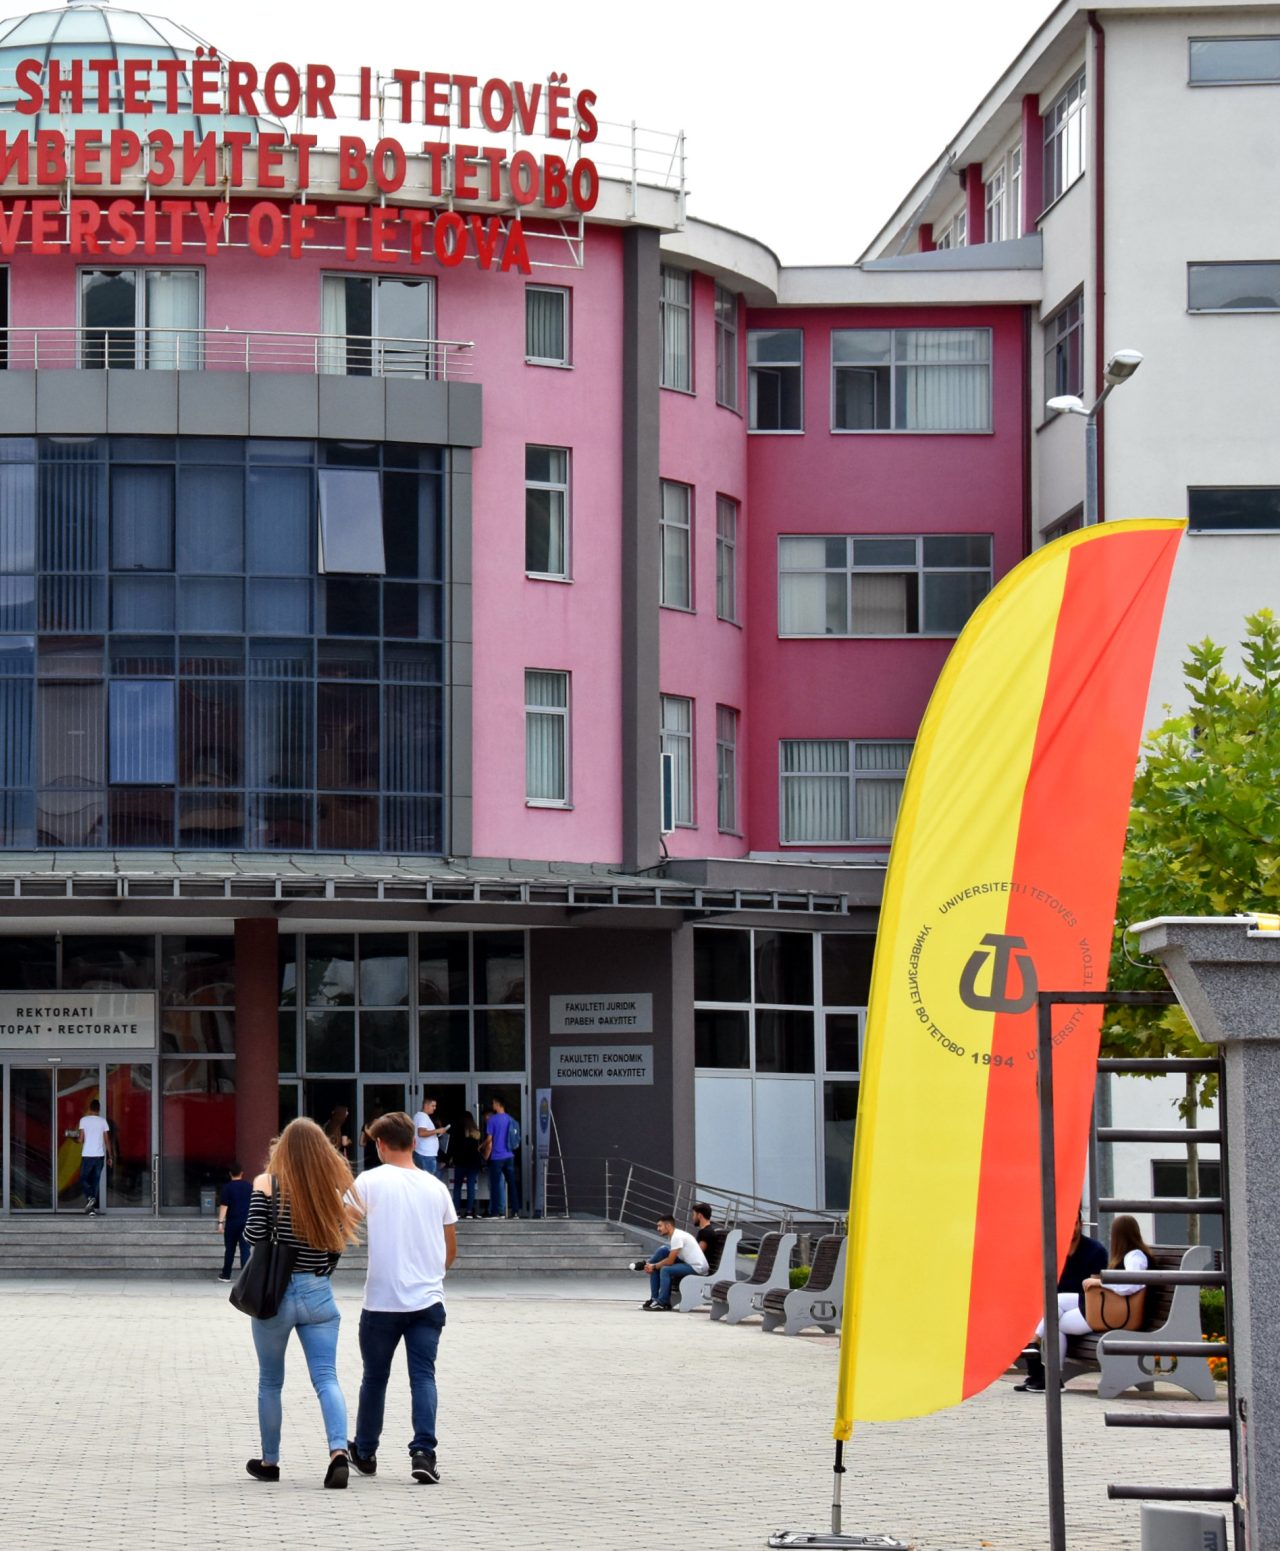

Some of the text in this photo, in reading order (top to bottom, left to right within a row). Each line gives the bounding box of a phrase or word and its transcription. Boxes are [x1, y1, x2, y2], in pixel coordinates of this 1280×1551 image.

[15, 46, 336, 119] SHTETËROR
[360, 66, 371, 121] I
[393, 71, 598, 143] TETOVËS
[339, 135, 407, 194] ВО
[424, 141, 600, 213] ТЕТОВО
[248, 201, 318, 259] OF
[335, 205, 533, 275] TETOVA
[939, 882, 1020, 914] UNIVERSITETI
[908, 925, 965, 1057] УНИВЕРЗИТЕТ ВО ТЕТОВО
[565, 1001, 636, 1012] FAKULTETI JURIDIK
[1027, 937, 1093, 1061] UERSITY TETOVA
[16, 1007, 93, 1018] REKTORATI
[564, 1016, 637, 1026] ПРАВЕН ФАКУЛТЕТ
[58, 1024, 138, 1034] RECTORATE
[560, 1053, 643, 1063] FAKULTETI EKONOMIK
[971, 1052, 1014, 1067] 1994
[557, 1068, 646, 1078] ЕКОНОМСКИ ФАКУЛТЕТ
